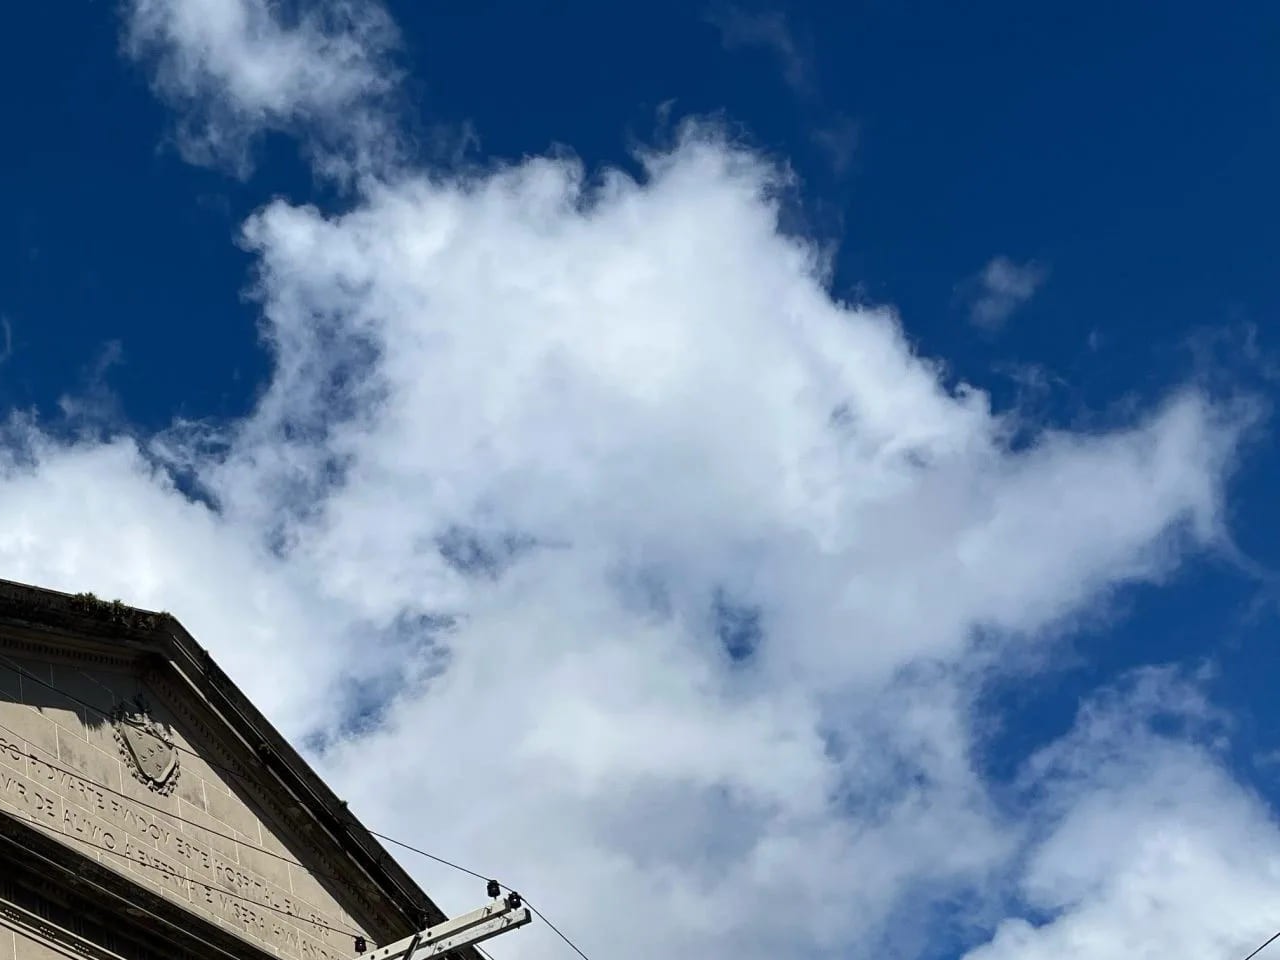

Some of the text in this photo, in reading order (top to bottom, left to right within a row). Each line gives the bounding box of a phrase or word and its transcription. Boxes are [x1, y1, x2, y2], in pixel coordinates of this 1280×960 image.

[35, 792, 56, 818] DE
[204, 885, 213, 904] E
[176, 837, 209, 869] ESTE
[213, 858, 279, 908] HOSPITAL
